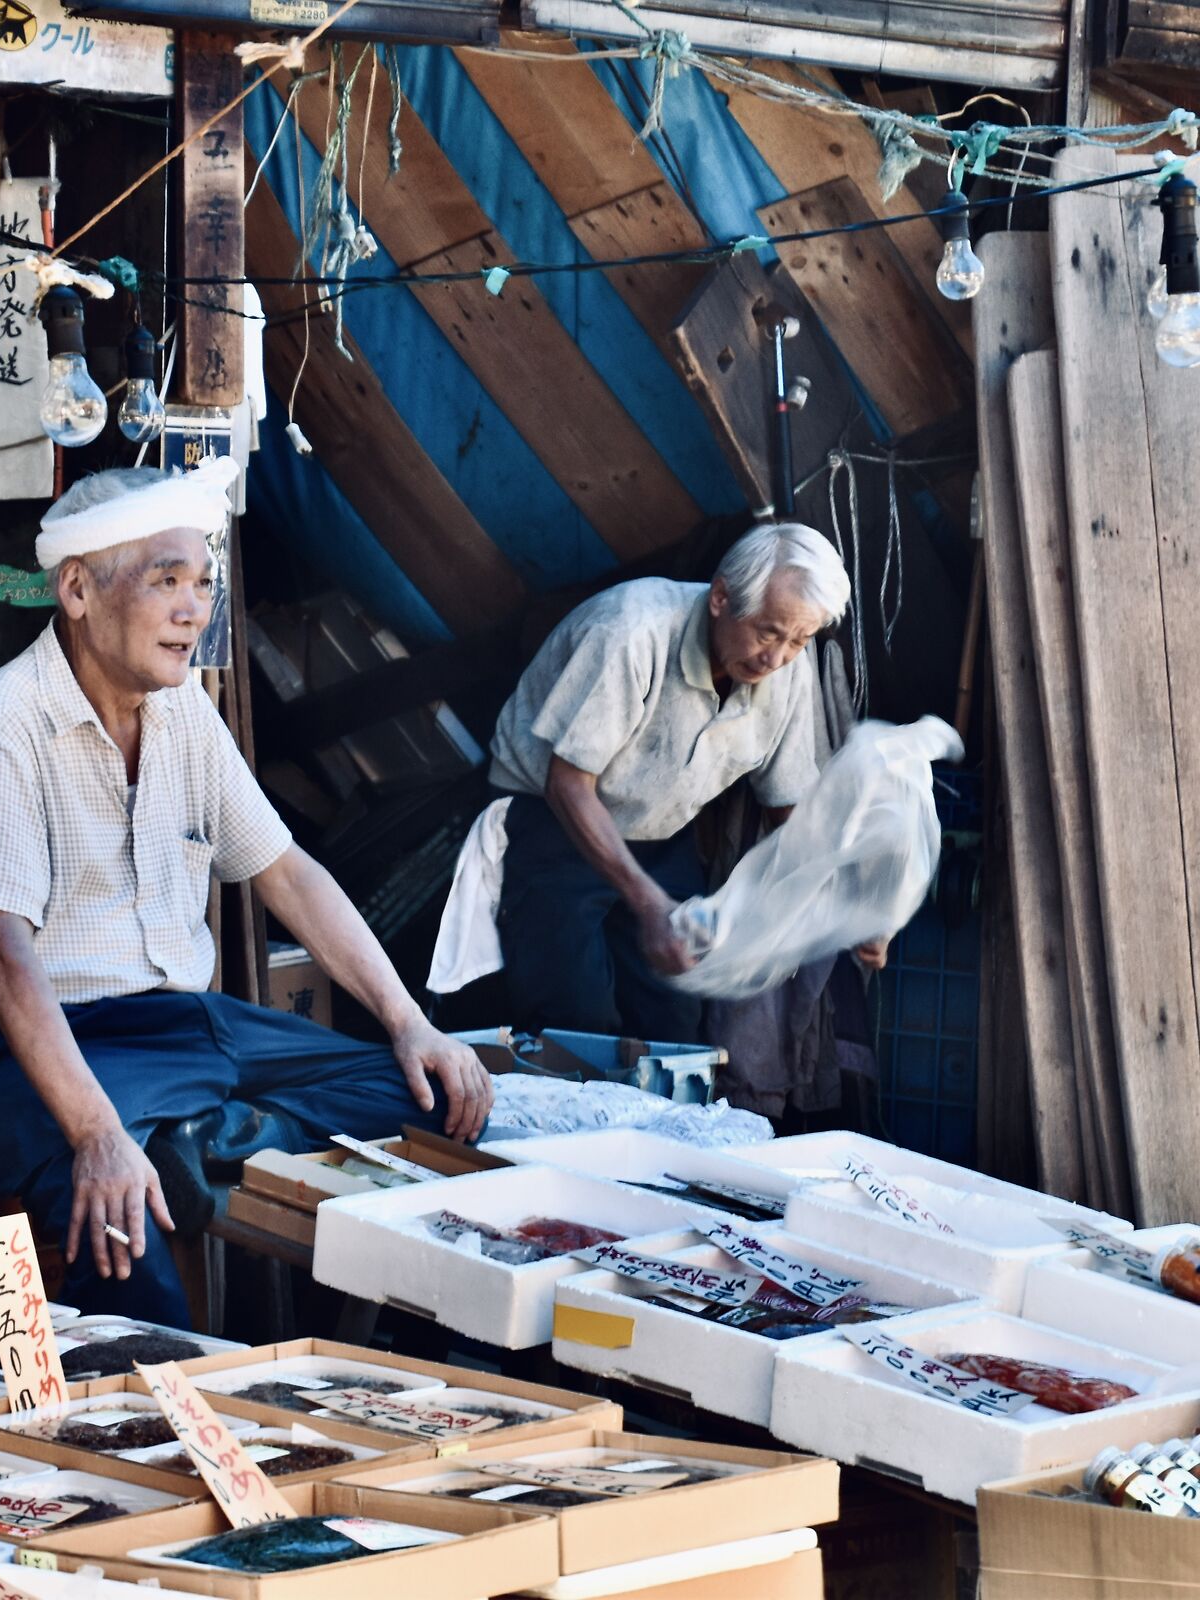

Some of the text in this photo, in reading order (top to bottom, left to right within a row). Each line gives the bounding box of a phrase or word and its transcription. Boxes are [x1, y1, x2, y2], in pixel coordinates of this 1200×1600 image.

[40, 23, 96, 56] クール
[10, 1229, 62, 1416] くるみちりめ
